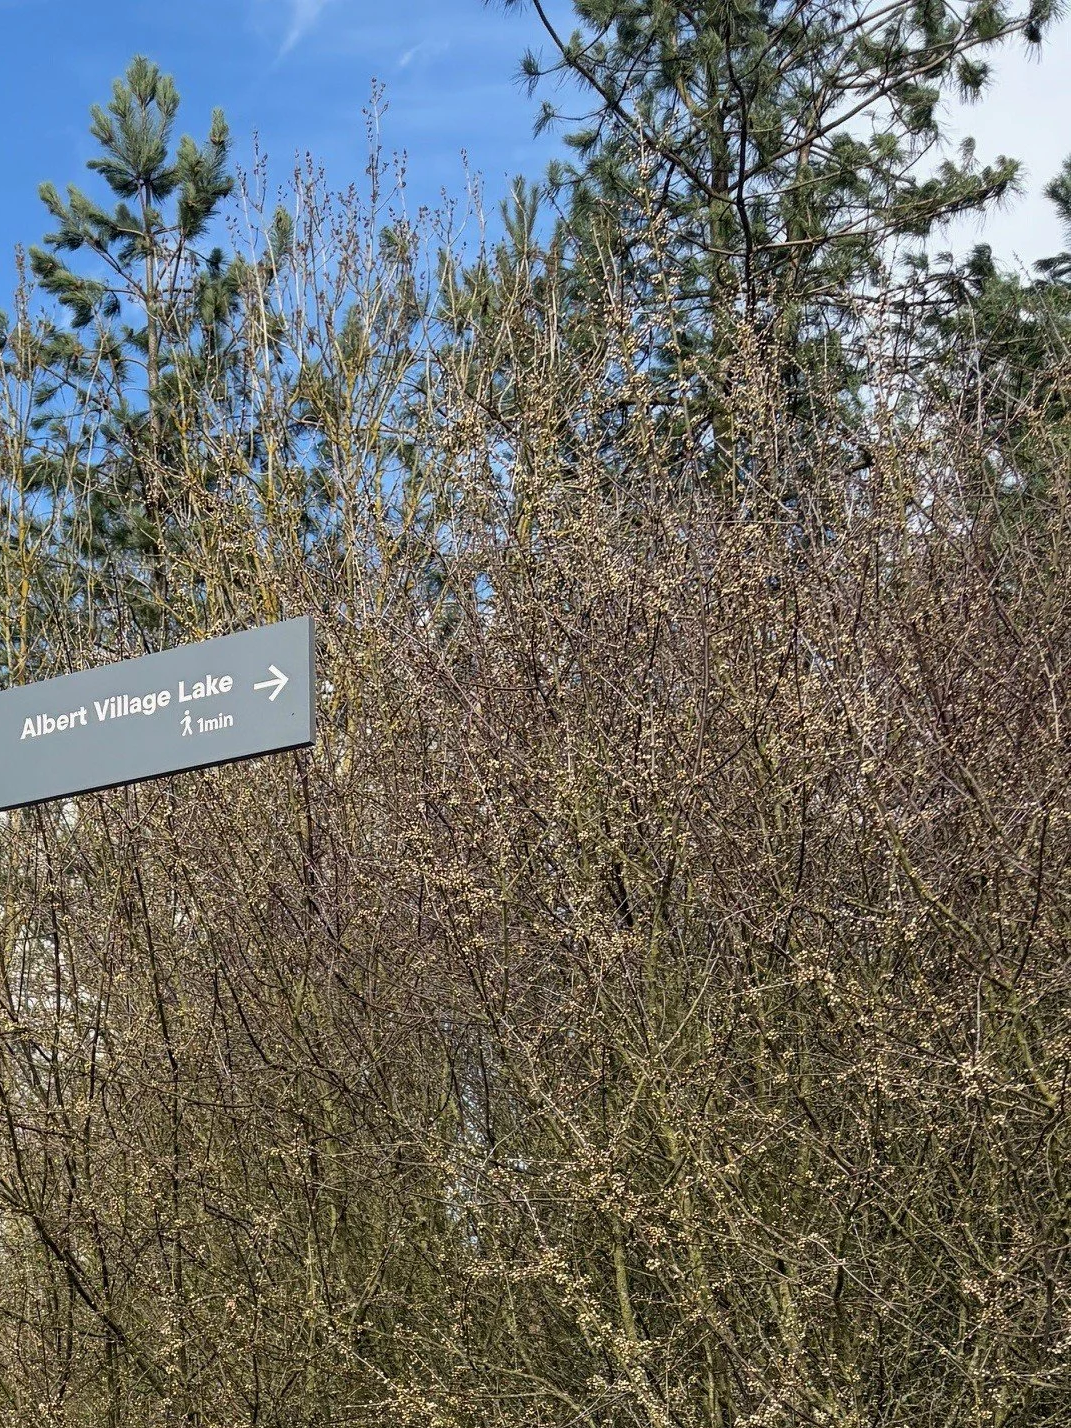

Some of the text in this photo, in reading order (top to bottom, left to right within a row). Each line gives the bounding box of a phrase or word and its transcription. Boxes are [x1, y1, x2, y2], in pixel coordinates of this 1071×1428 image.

[20, 675, 233, 739] Albert Village Lake
[196, 714, 233, 732] 1min
